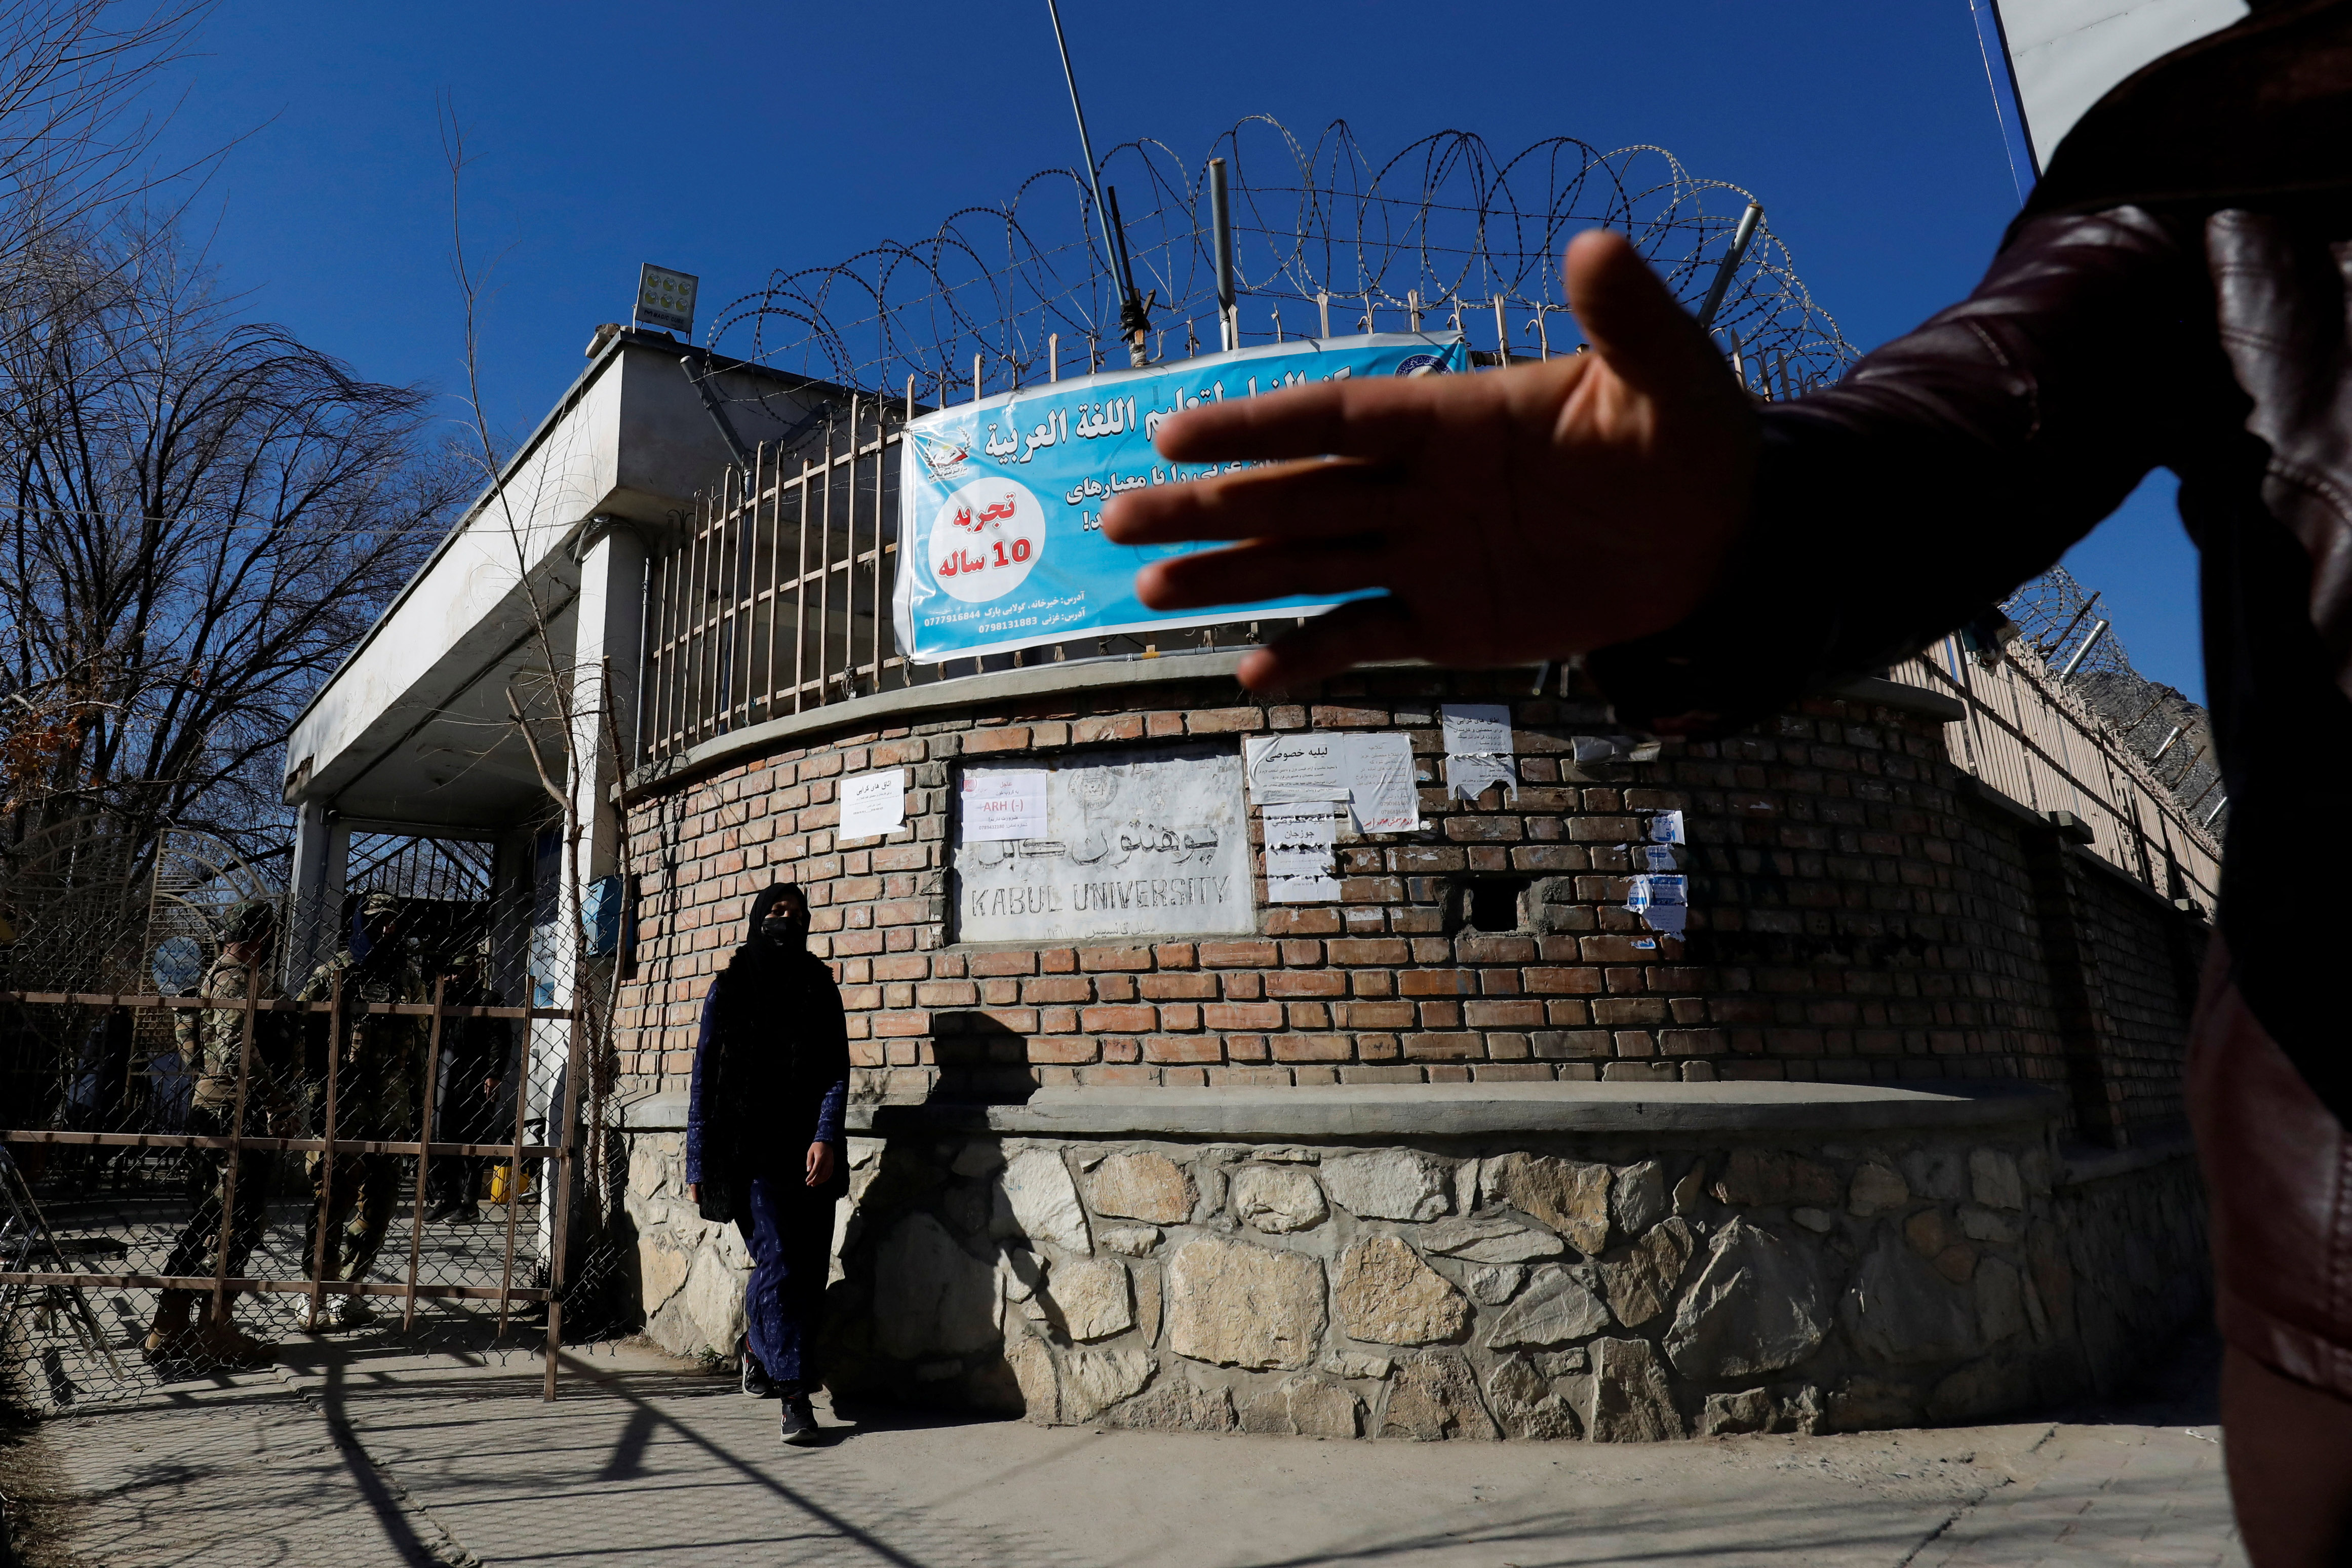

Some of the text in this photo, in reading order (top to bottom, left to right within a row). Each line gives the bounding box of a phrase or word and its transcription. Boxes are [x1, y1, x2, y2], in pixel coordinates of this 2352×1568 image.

[1076, 395, 1135, 439] اللغة
[985, 407, 1068, 465] العربية
[953, 492, 1016, 533] تجربه
[938, 537, 1032, 578] 10 ساله
[1061, 591, 1085, 605] آدرس:
[924, 610, 980, 627] 0777916844
[978, 607, 1086, 633] آدرس: غزنی 0798131883
[1266, 746, 1328, 762] لیلیه خصوصی
[983, 801, 1007, 811] ARH
[1072, 820, 1220, 870] پوهنتون
[1284, 830, 1314, 839] جوزجان
[971, 875, 1231, 917] KABUL UNIVERSITY
[1131, 921, 1156, 935] سال
